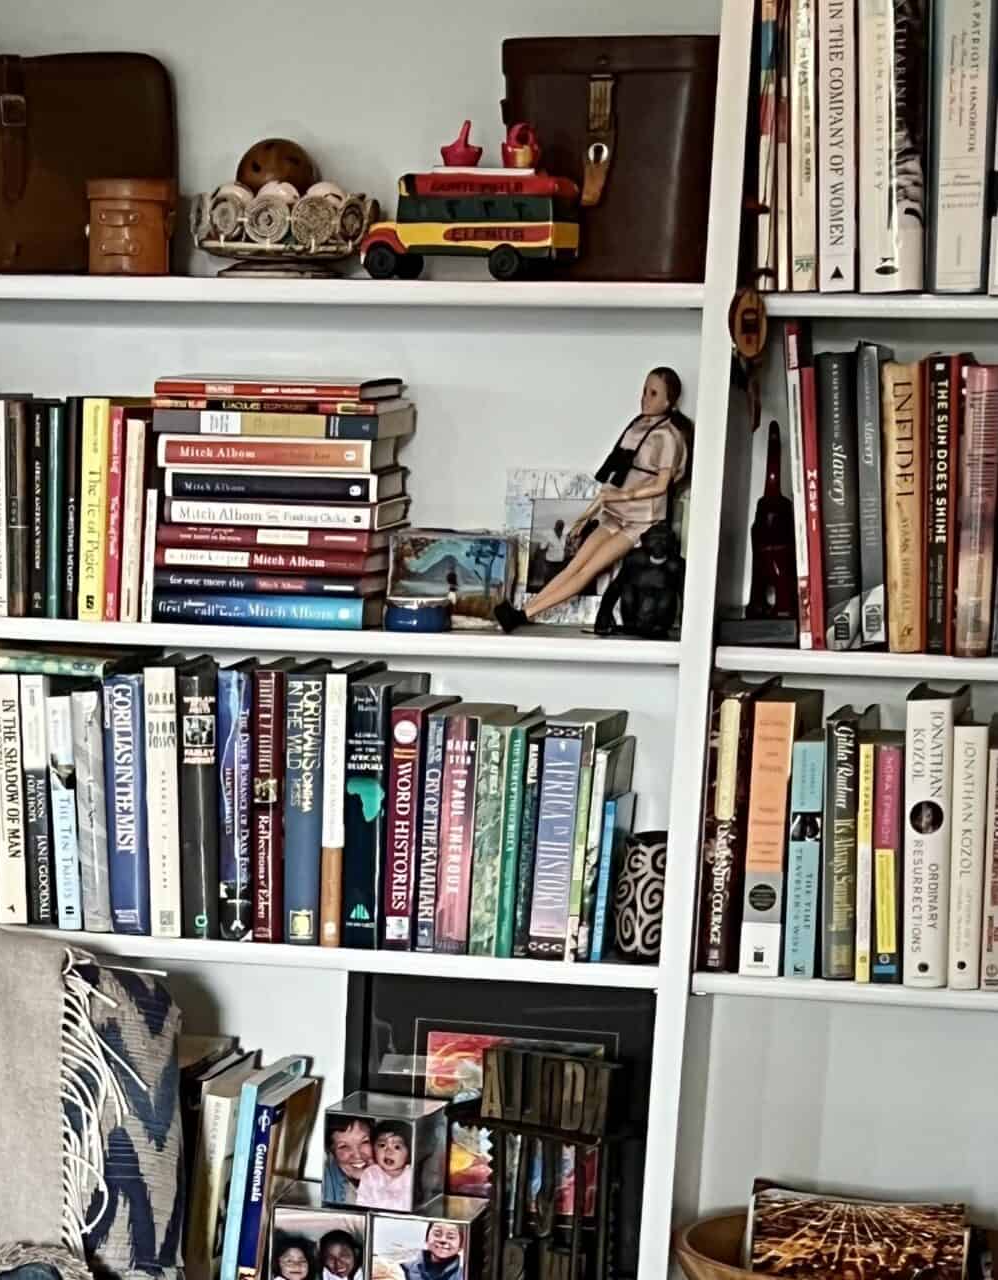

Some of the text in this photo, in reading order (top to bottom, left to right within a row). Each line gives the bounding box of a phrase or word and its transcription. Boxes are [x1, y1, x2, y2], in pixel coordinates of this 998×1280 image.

[829, 2, 844, 246] IN THE COMPANY OF WOMEN
[967, 86, 978, 153] HANDBOOK
[874, 114, 885, 191] HISTORY
[179, 445, 256, 459] Mitch Albom
[862, 420, 877, 467] slavery
[893, 381, 914, 497] INFIDEL
[935, 379, 948, 544] THE SUN DOES SHINE
[87, 467, 103, 496] The
[184, 480, 246, 492] Mitch Albom
[829, 442, 848, 506] slavery
[34, 460, 42, 538] AFRICAN AMERICAN
[179, 505, 215, 520] Mitch
[218, 507, 262, 521] Albom
[67, 505, 76, 553] CHRISTMAS
[86, 520, 101, 534] of
[66, 554, 75, 592] MEMORY
[82, 540, 101, 580] Piglet
[170, 576, 182, 585] for
[203, 579, 226, 587] more
[228, 578, 245, 590] day
[253, 554, 326, 568] Mitch Albom
[159, 600, 216, 618] first call
[248, 602, 333, 620] Mitch Albom
[148, 720, 176, 734] DIAN
[239, 708, 250, 730] THE
[287, 680, 302, 769] IN THE WILD
[301, 680, 321, 770] PORTRAITS
[112, 683, 136, 854] GORILLAS IN THE MIST
[239, 732, 250, 762] DARK
[350, 754, 382, 762] AFRICAN
[446, 739, 476, 751] DARK
[513, 738, 522, 755] THE
[833, 725, 855, 809] Gilda Radner
[911, 727, 925, 784] KOZOL
[928, 710, 944, 798] JONATHAN
[1, 699, 21, 859] IN THE SHADOW OF MAN
[238, 764, 250, 812] ROMANCE
[425, 768, 441, 796] CRY
[882, 755, 894, 791] NORA
[26, 774, 38, 823] FOR HOPE
[34, 778, 46, 818] REASON
[57, 797, 70, 822] THE
[239, 814, 249, 826] OF
[423, 798, 440, 816] OF
[880, 794, 892, 846] EPHRON
[958, 740, 977, 880] JONATHAN KOZOL
[59, 826, 72, 852] TEN
[239, 829, 250, 855] DIAN
[392, 761, 412, 911] WORD HISTORIES
[421, 818, 439, 848] THE
[446, 779, 467, 896] PAUL THEROUX
[536, 759, 579, 911] AFRICA IN HISTORY
[829, 837, 854, 875] Always
[36, 833, 50, 920] JANE GOODALL
[257, 815, 272, 919] Reflections Eden
[418, 849, 438, 923] KALAHARI
[709, 824, 731, 945] UNDAUNTED COURAGE
[792, 847, 804, 921] TRAVELER'S
[802, 872, 814, 931] THE TIME
[828, 875, 854, 934] Something
[910, 838, 925, 954] RESURRECTIONS
[927, 863, 940, 929] ORDINARY
[250, 1143, 268, 1203] Guatemala
